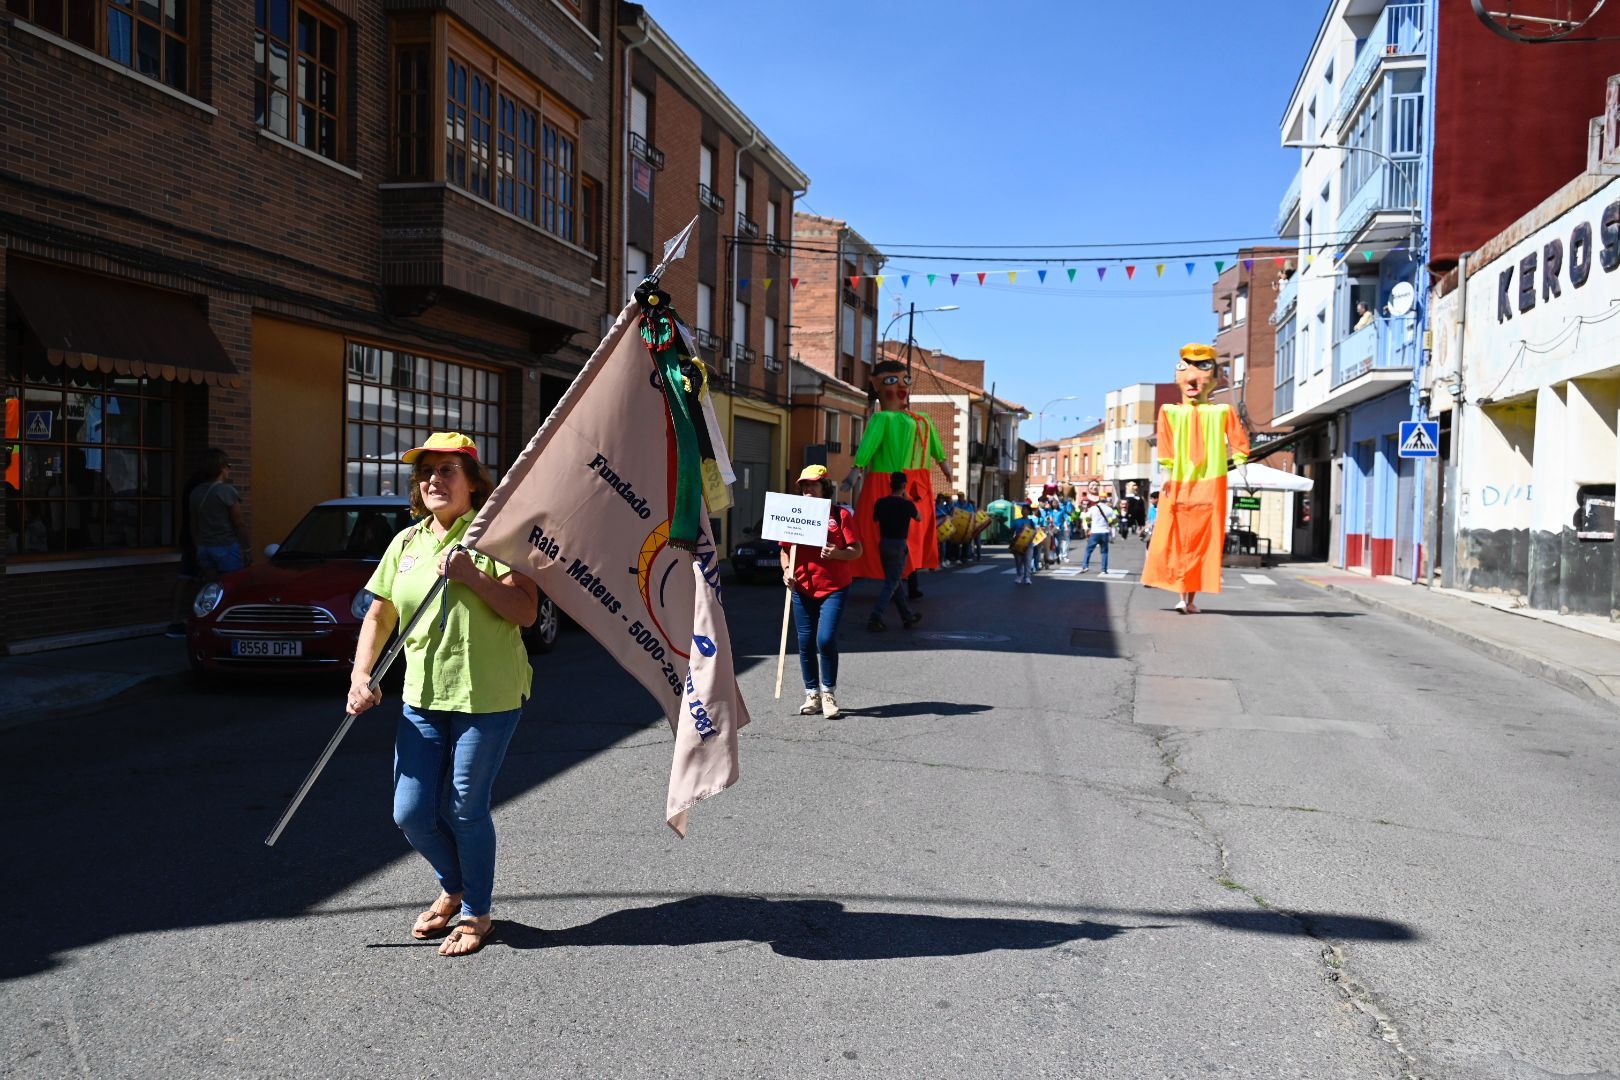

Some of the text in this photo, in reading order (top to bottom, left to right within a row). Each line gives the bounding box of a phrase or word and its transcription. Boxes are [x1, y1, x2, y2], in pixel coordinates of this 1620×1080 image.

[1498, 200, 1620, 325] KEROS
[587, 453, 650, 519] Fundado
[770, 514, 822, 527] TROVADORES
[528, 525, 560, 562] Raia
[566, 558, 622, 614] Mateus
[628, 620, 684, 697] 5000-285
[240, 641, 297, 655] 8558 DFH
[689, 699, 717, 741] 1981
